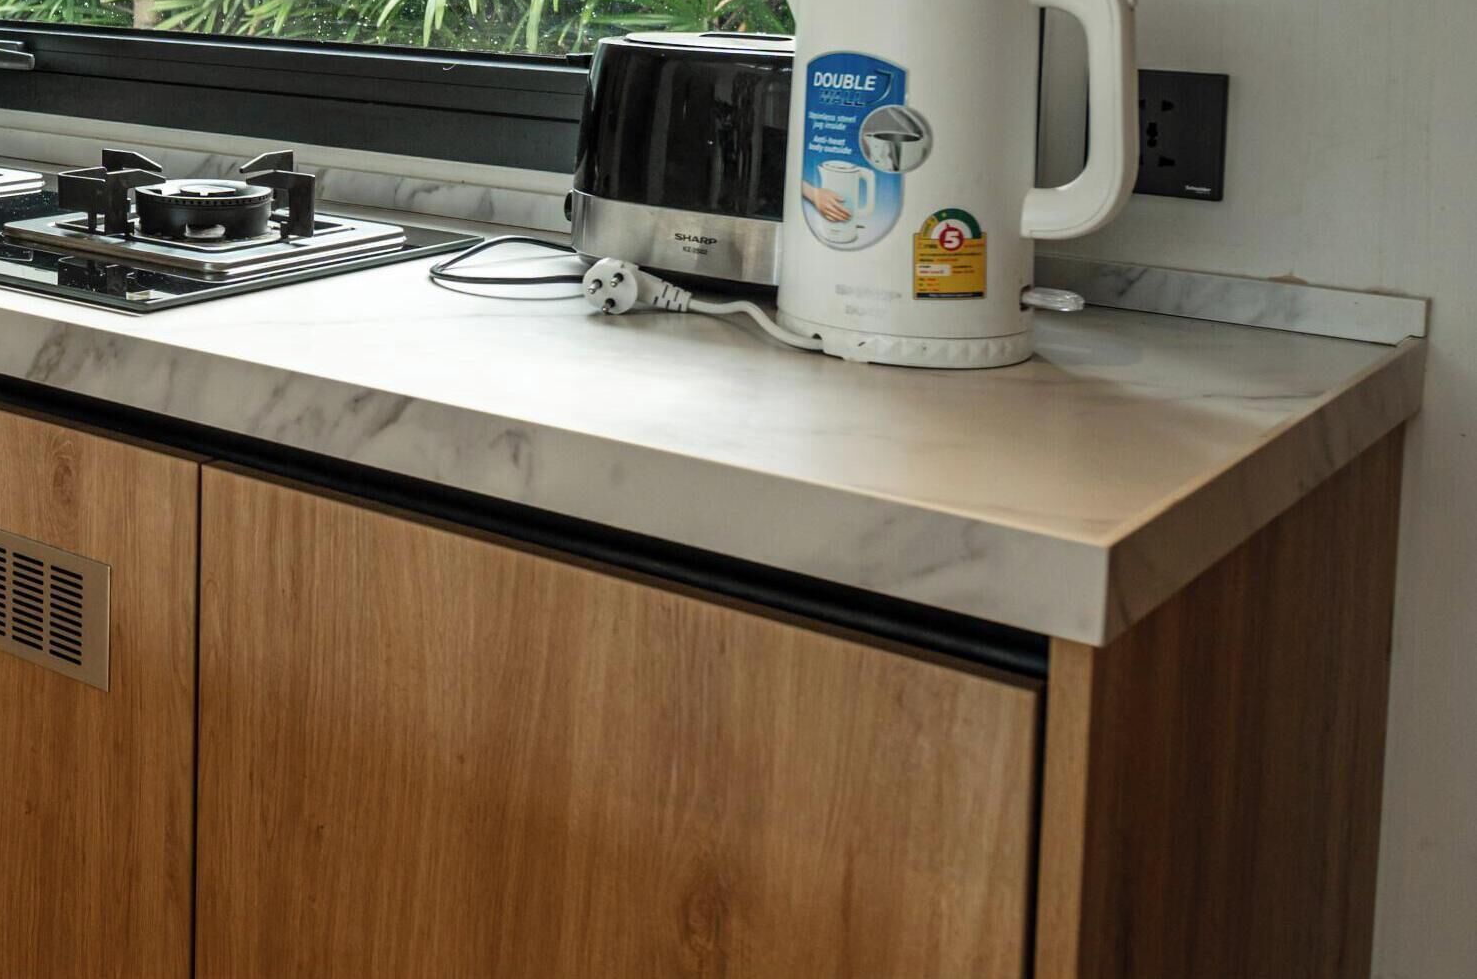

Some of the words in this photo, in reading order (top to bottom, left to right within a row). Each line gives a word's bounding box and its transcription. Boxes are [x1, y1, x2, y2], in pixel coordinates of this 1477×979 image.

[813, 71, 877, 91] DOUBLE
[674, 233, 717, 245] SHARP
[943, 230, 961, 248] 5
